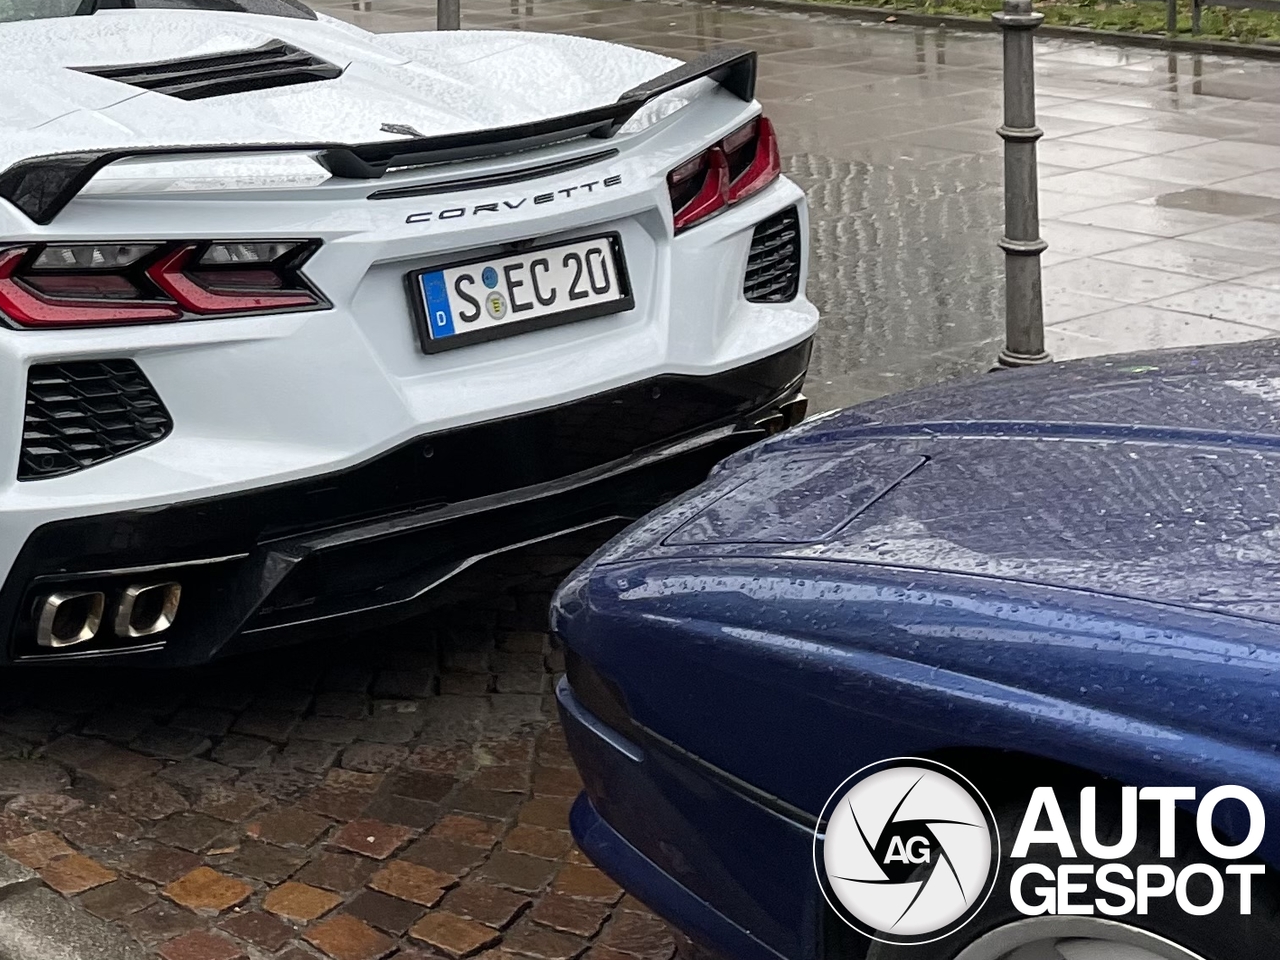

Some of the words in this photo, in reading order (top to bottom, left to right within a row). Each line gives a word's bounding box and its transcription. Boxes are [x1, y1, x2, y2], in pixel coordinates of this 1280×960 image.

[405, 174, 622, 224] CORVETTE
[454, 273, 481, 323] S
[503, 258, 557, 313] EC
[562, 247, 611, 301] 20
[436, 311, 447, 326] D
